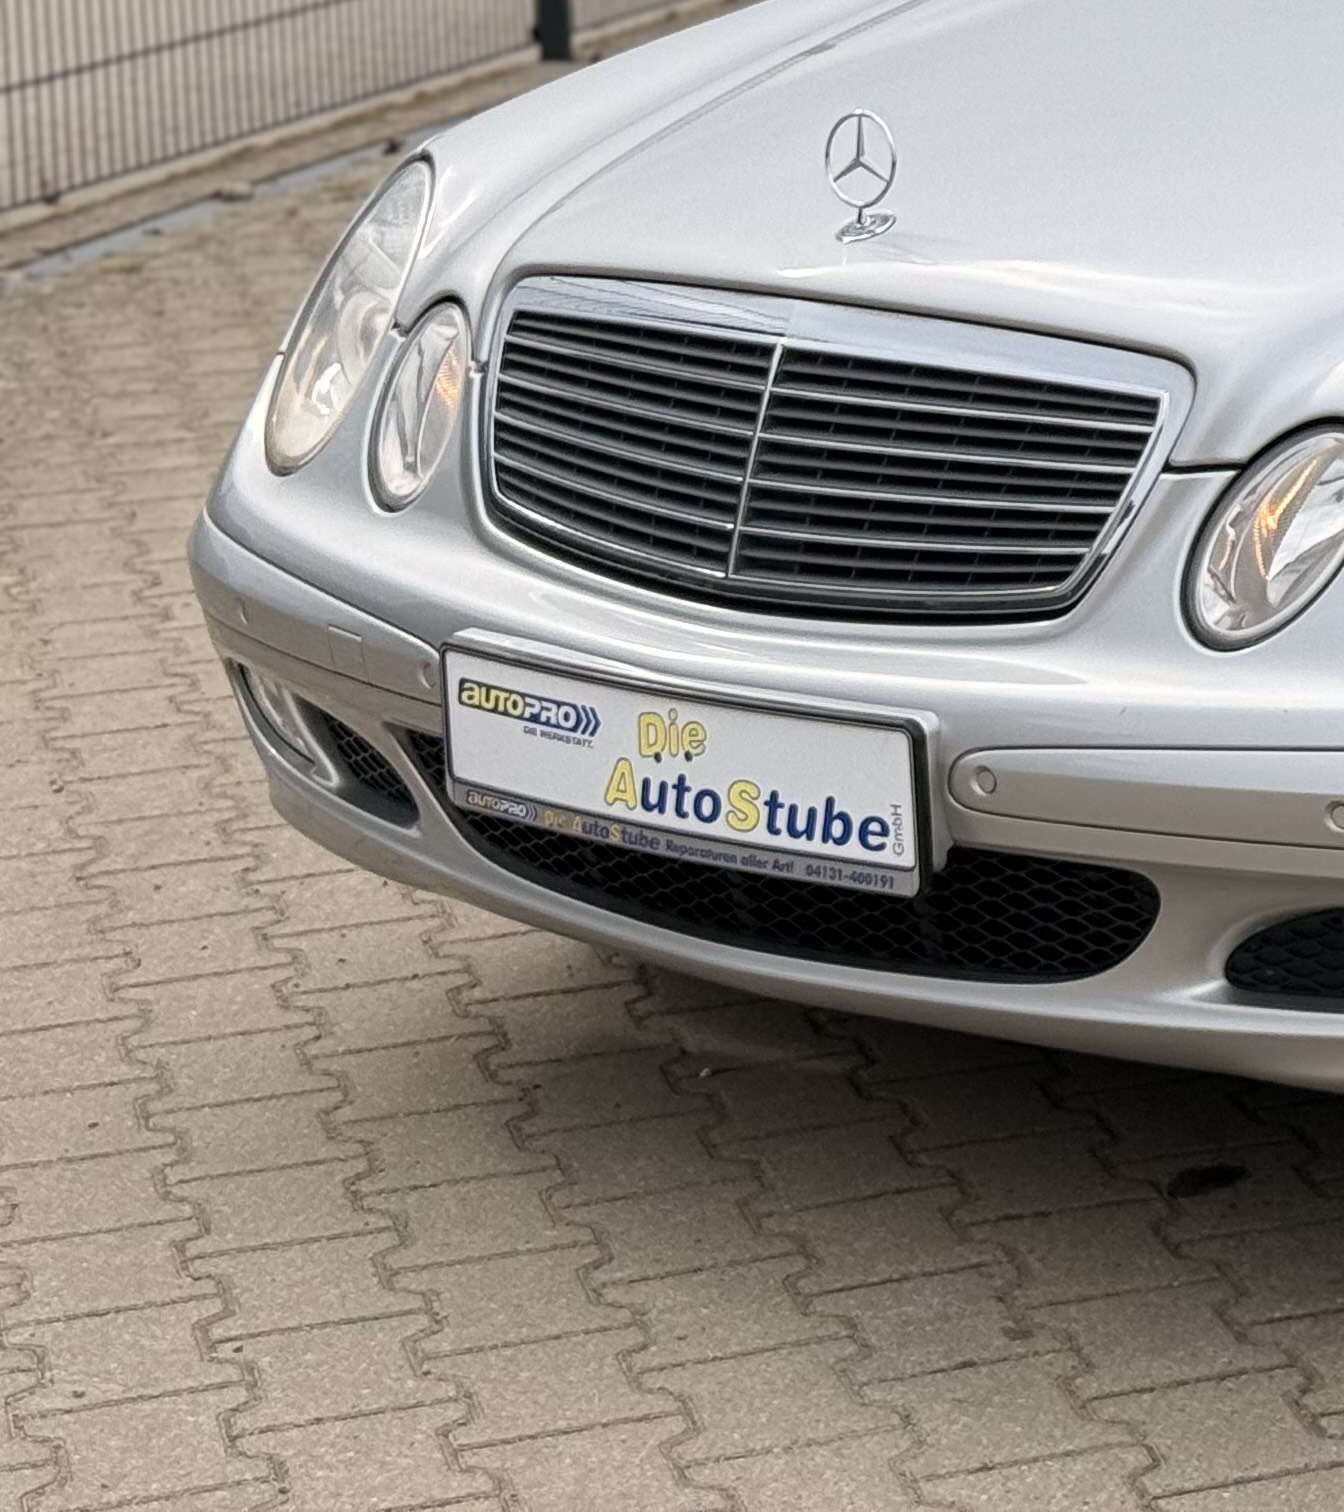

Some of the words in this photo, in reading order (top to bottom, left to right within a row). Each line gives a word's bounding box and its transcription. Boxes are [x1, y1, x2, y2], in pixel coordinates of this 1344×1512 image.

[637, 707, 707, 758] Die
[604, 756, 891, 852] AutoStube
[890, 803, 905, 857] GmbH
[571, 815, 661, 850] AutoStube
[665, 838, 738, 865] Reparaturen
